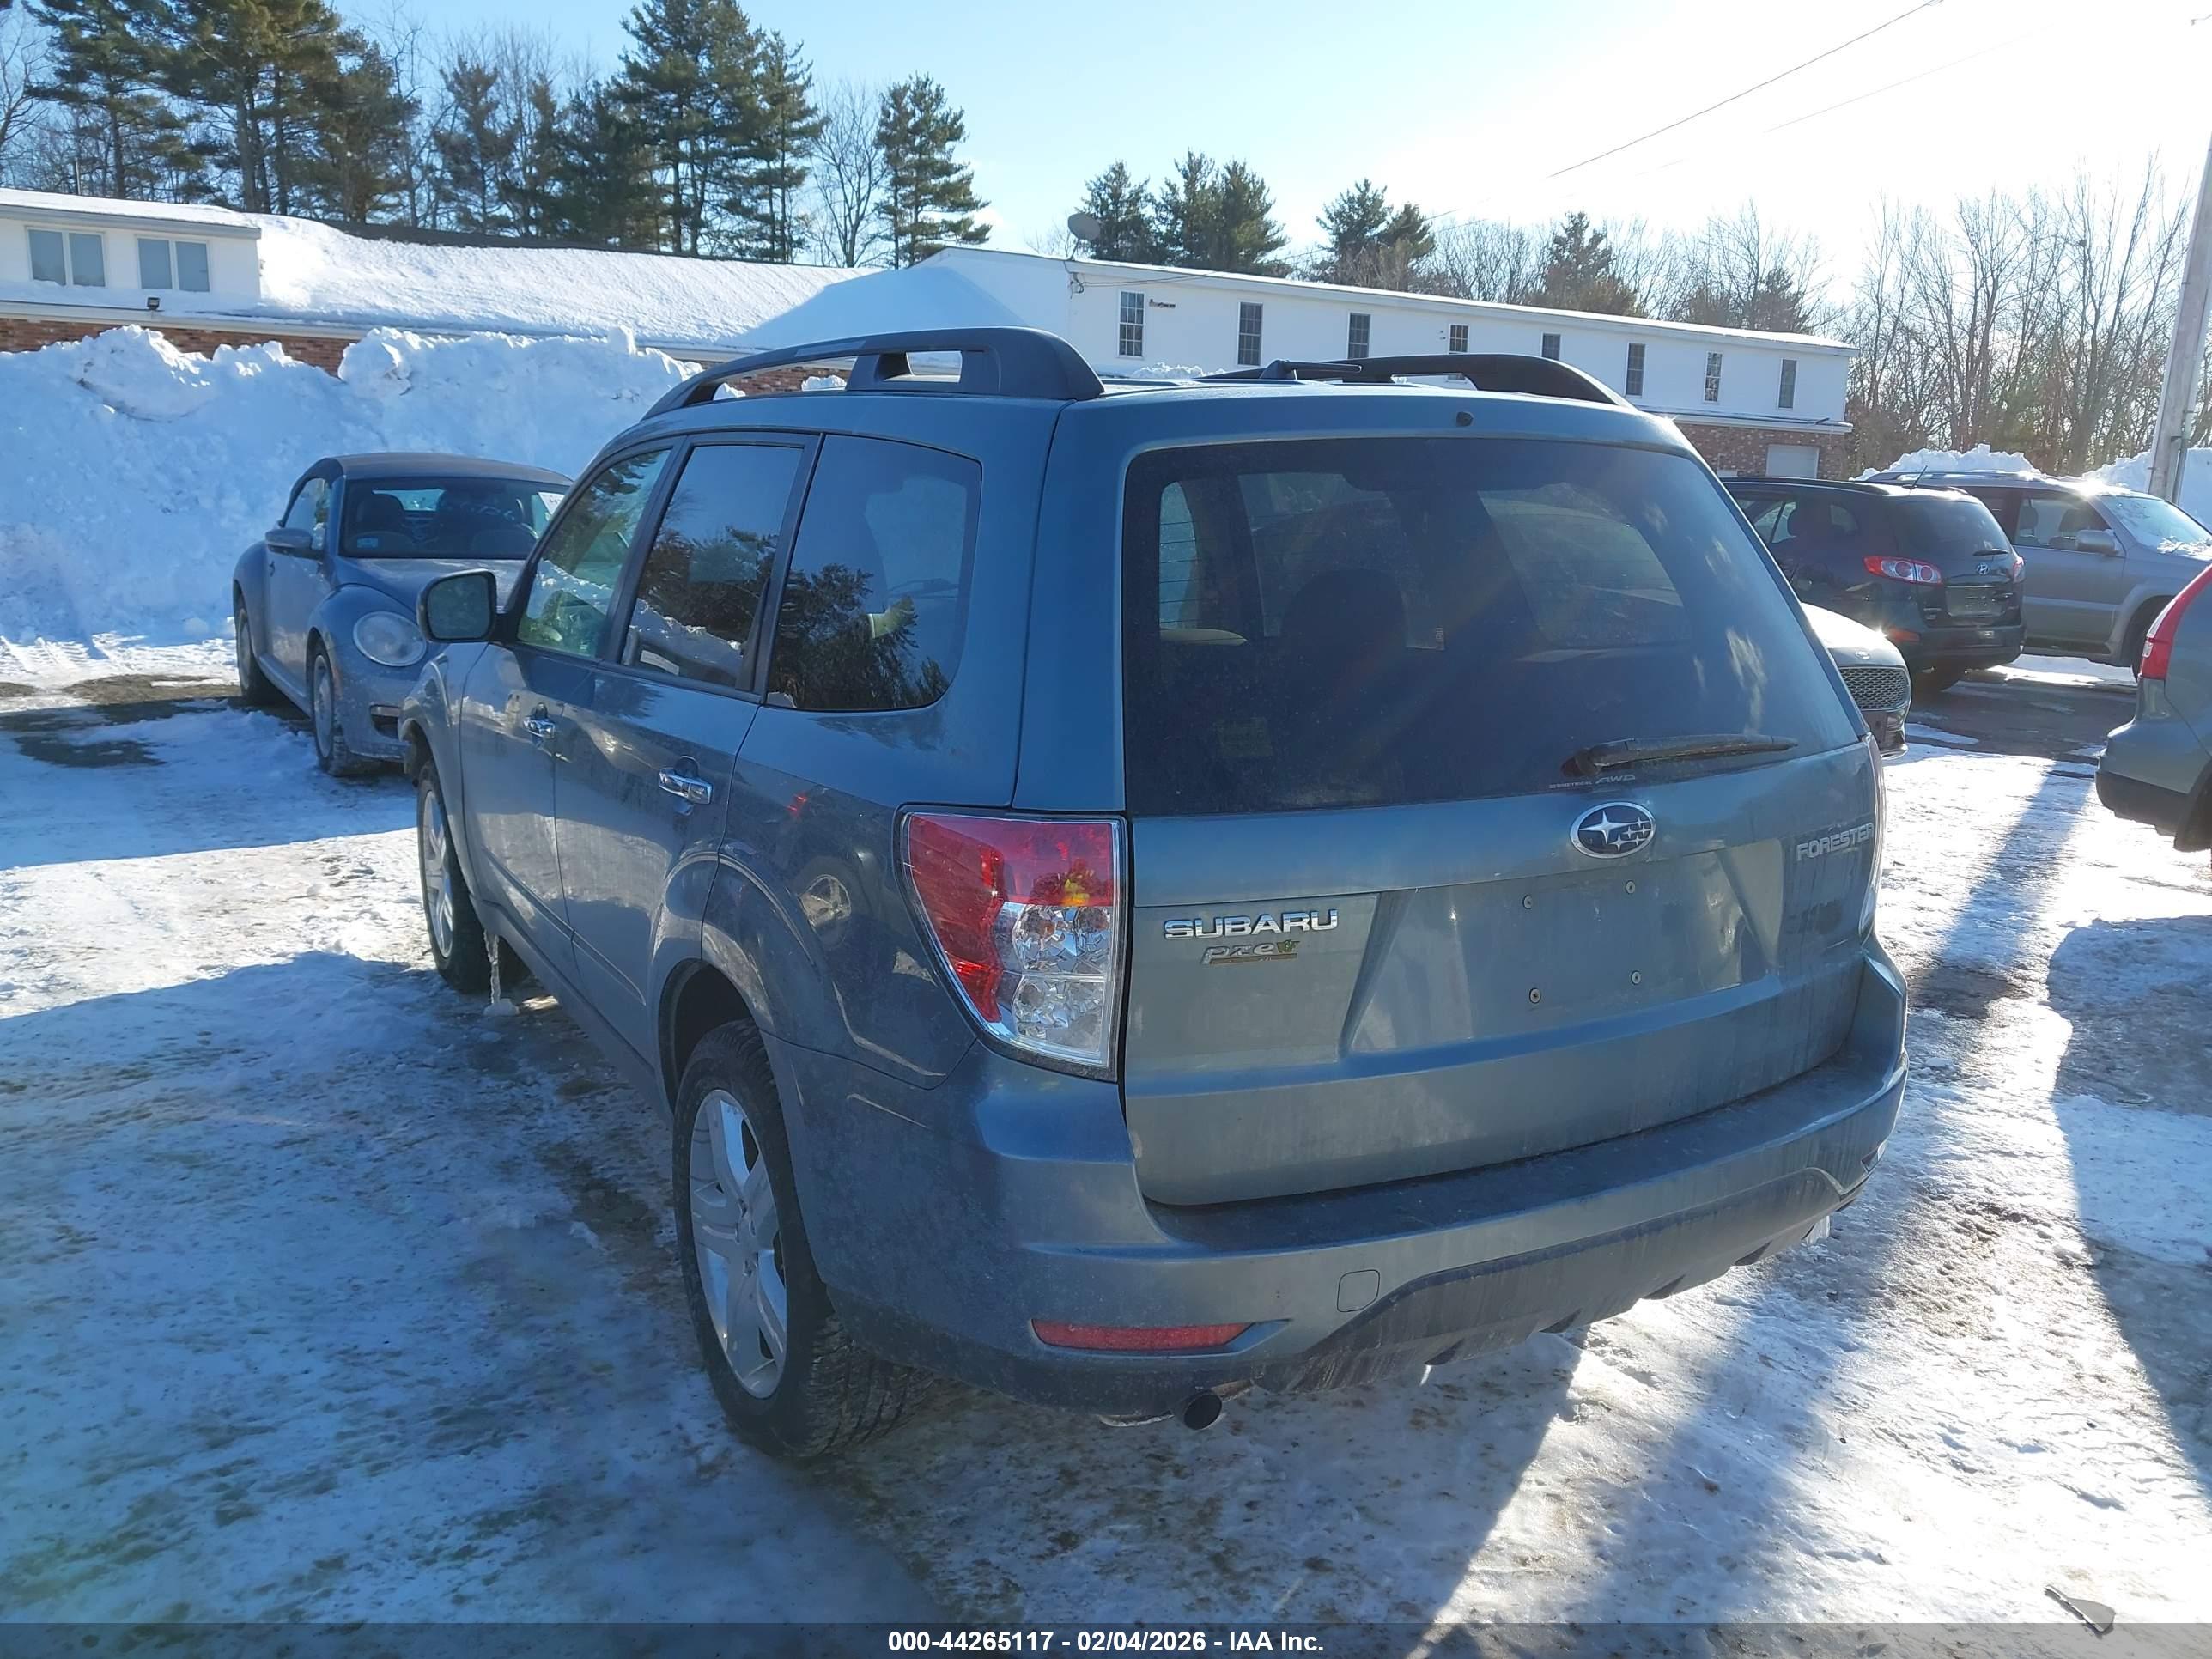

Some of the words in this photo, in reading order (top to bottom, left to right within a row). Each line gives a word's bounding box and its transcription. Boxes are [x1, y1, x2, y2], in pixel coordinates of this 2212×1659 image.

[1595, 774, 1636, 784] AWD
[1796, 822, 1875, 861] FORESTER
[1164, 908, 1339, 940] SUBARU
